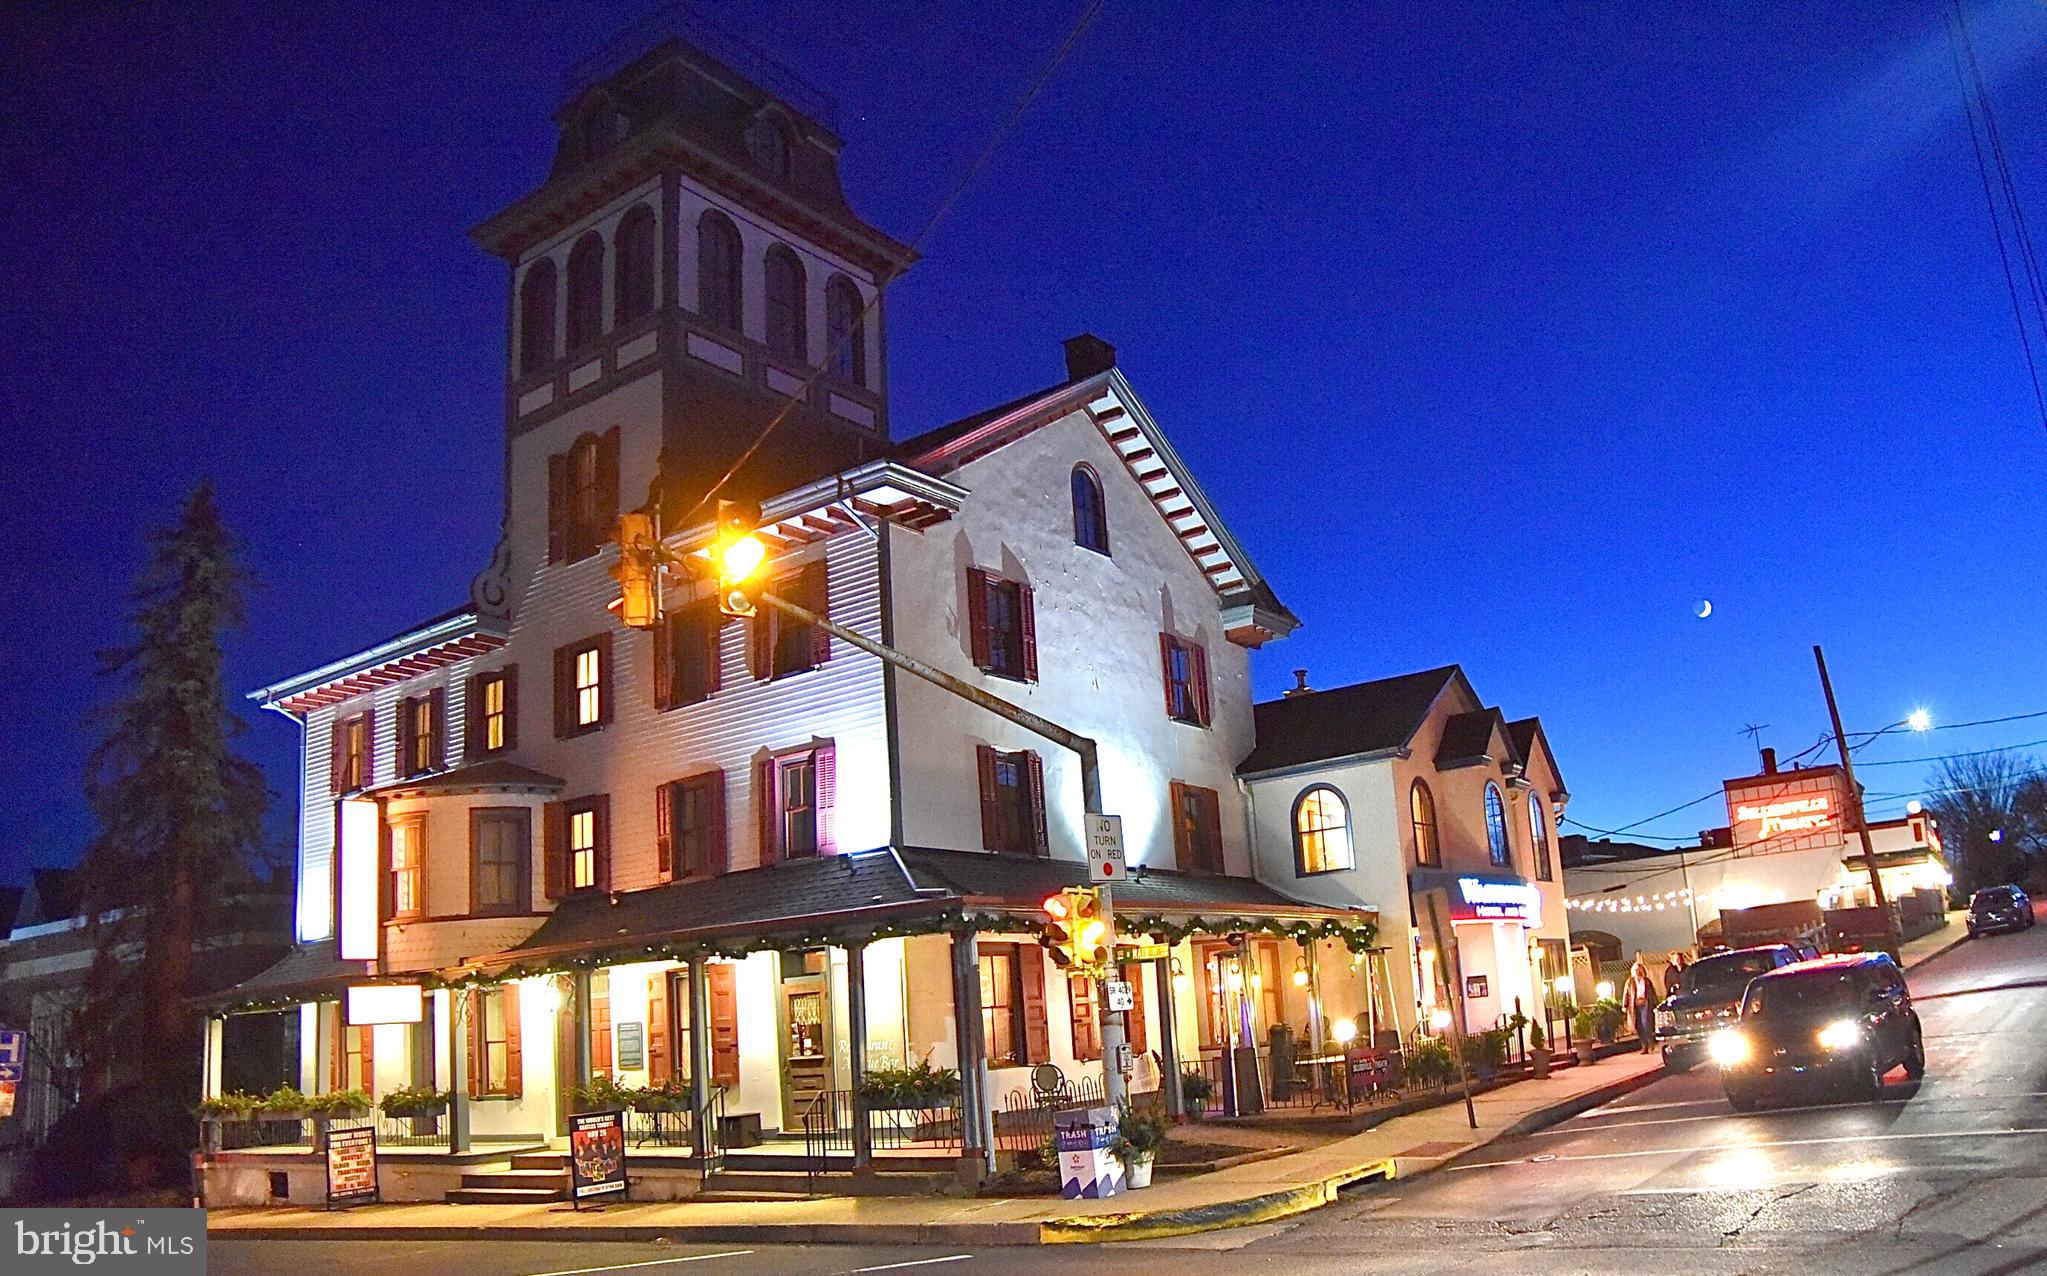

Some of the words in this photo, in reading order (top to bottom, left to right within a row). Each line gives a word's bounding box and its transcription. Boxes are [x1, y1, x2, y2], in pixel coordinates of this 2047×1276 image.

[1096, 819, 1110, 831] NO
[1094, 836, 1116, 846] TURN
[1090, 849, 1101, 859] ON
[1107, 850, 1122, 860] RED
[1060, 1130, 1087, 1140] TRASH
